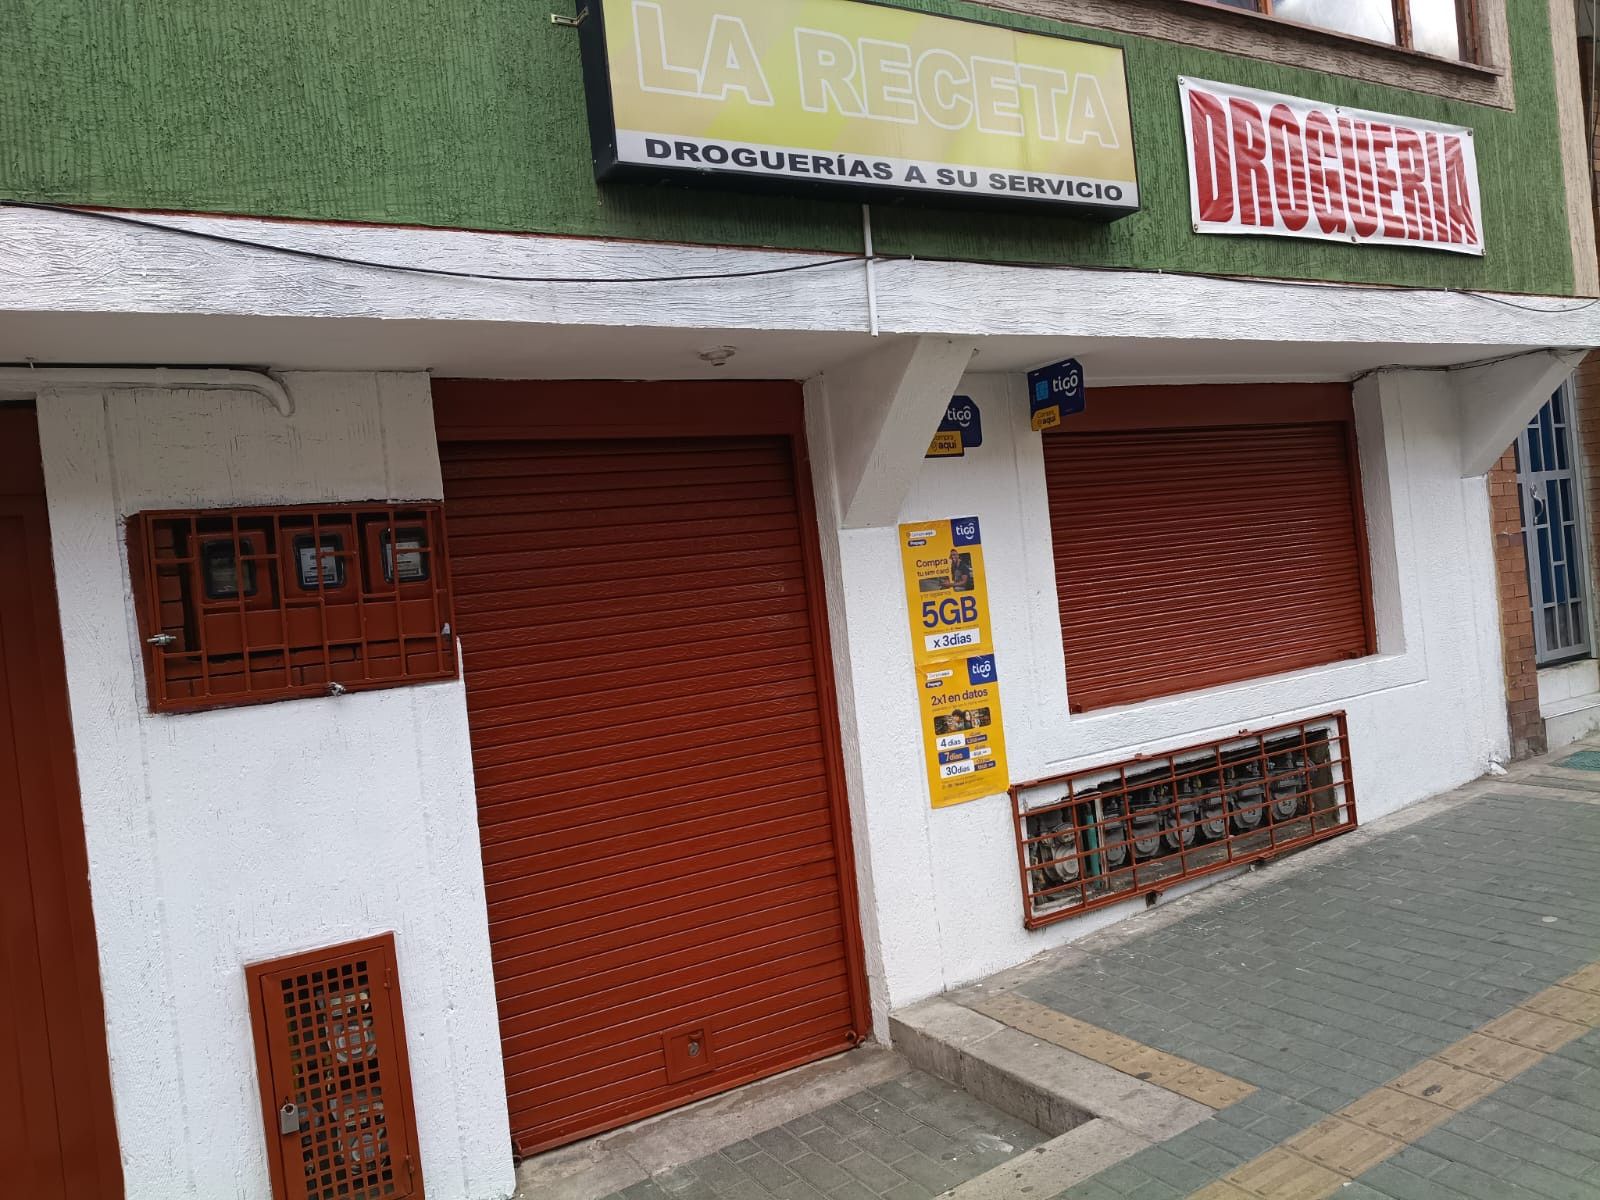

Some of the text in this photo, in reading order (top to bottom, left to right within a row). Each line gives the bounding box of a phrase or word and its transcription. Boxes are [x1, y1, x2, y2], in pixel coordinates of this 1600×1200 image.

[631, 0, 1120, 150] LA RECETA
[644, 137, 1124, 203] DROGUERÍAS A SU SERVICIO
[1188, 88, 1479, 245] DROGUERIA
[915, 557, 948, 569] Compra
[922, 596, 978, 628] 5GB
[930, 693, 947, 706] 2x1
[948, 692, 961, 703] en
[961, 688, 988, 701] datos
[940, 738, 947, 748] 4
